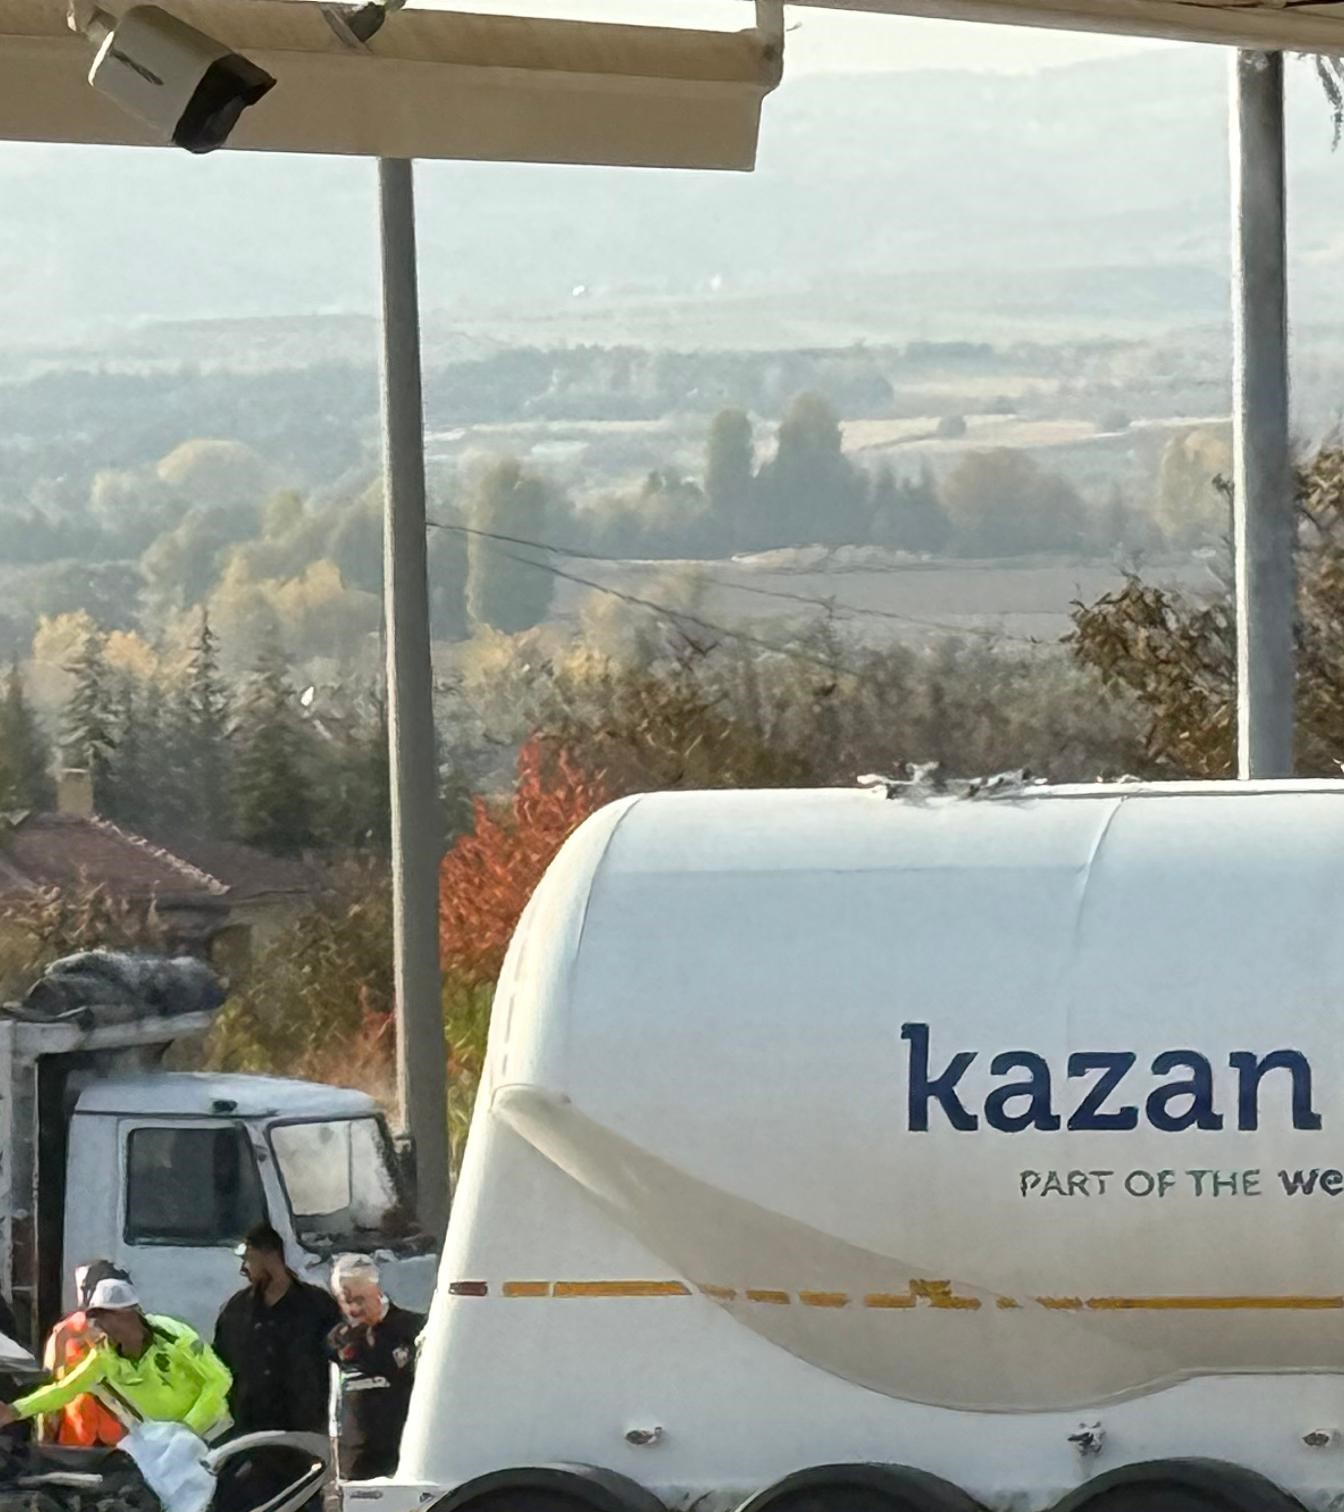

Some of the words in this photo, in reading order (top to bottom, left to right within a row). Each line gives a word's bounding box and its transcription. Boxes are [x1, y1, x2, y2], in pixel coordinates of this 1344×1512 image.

[900, 1021, 1323, 1134] kazan
[1020, 1169, 1115, 1198] PART
[1124, 1168, 1177, 1198] OF
[1185, 1168, 1262, 1198] THE
[1278, 1168, 1344, 1197] we
